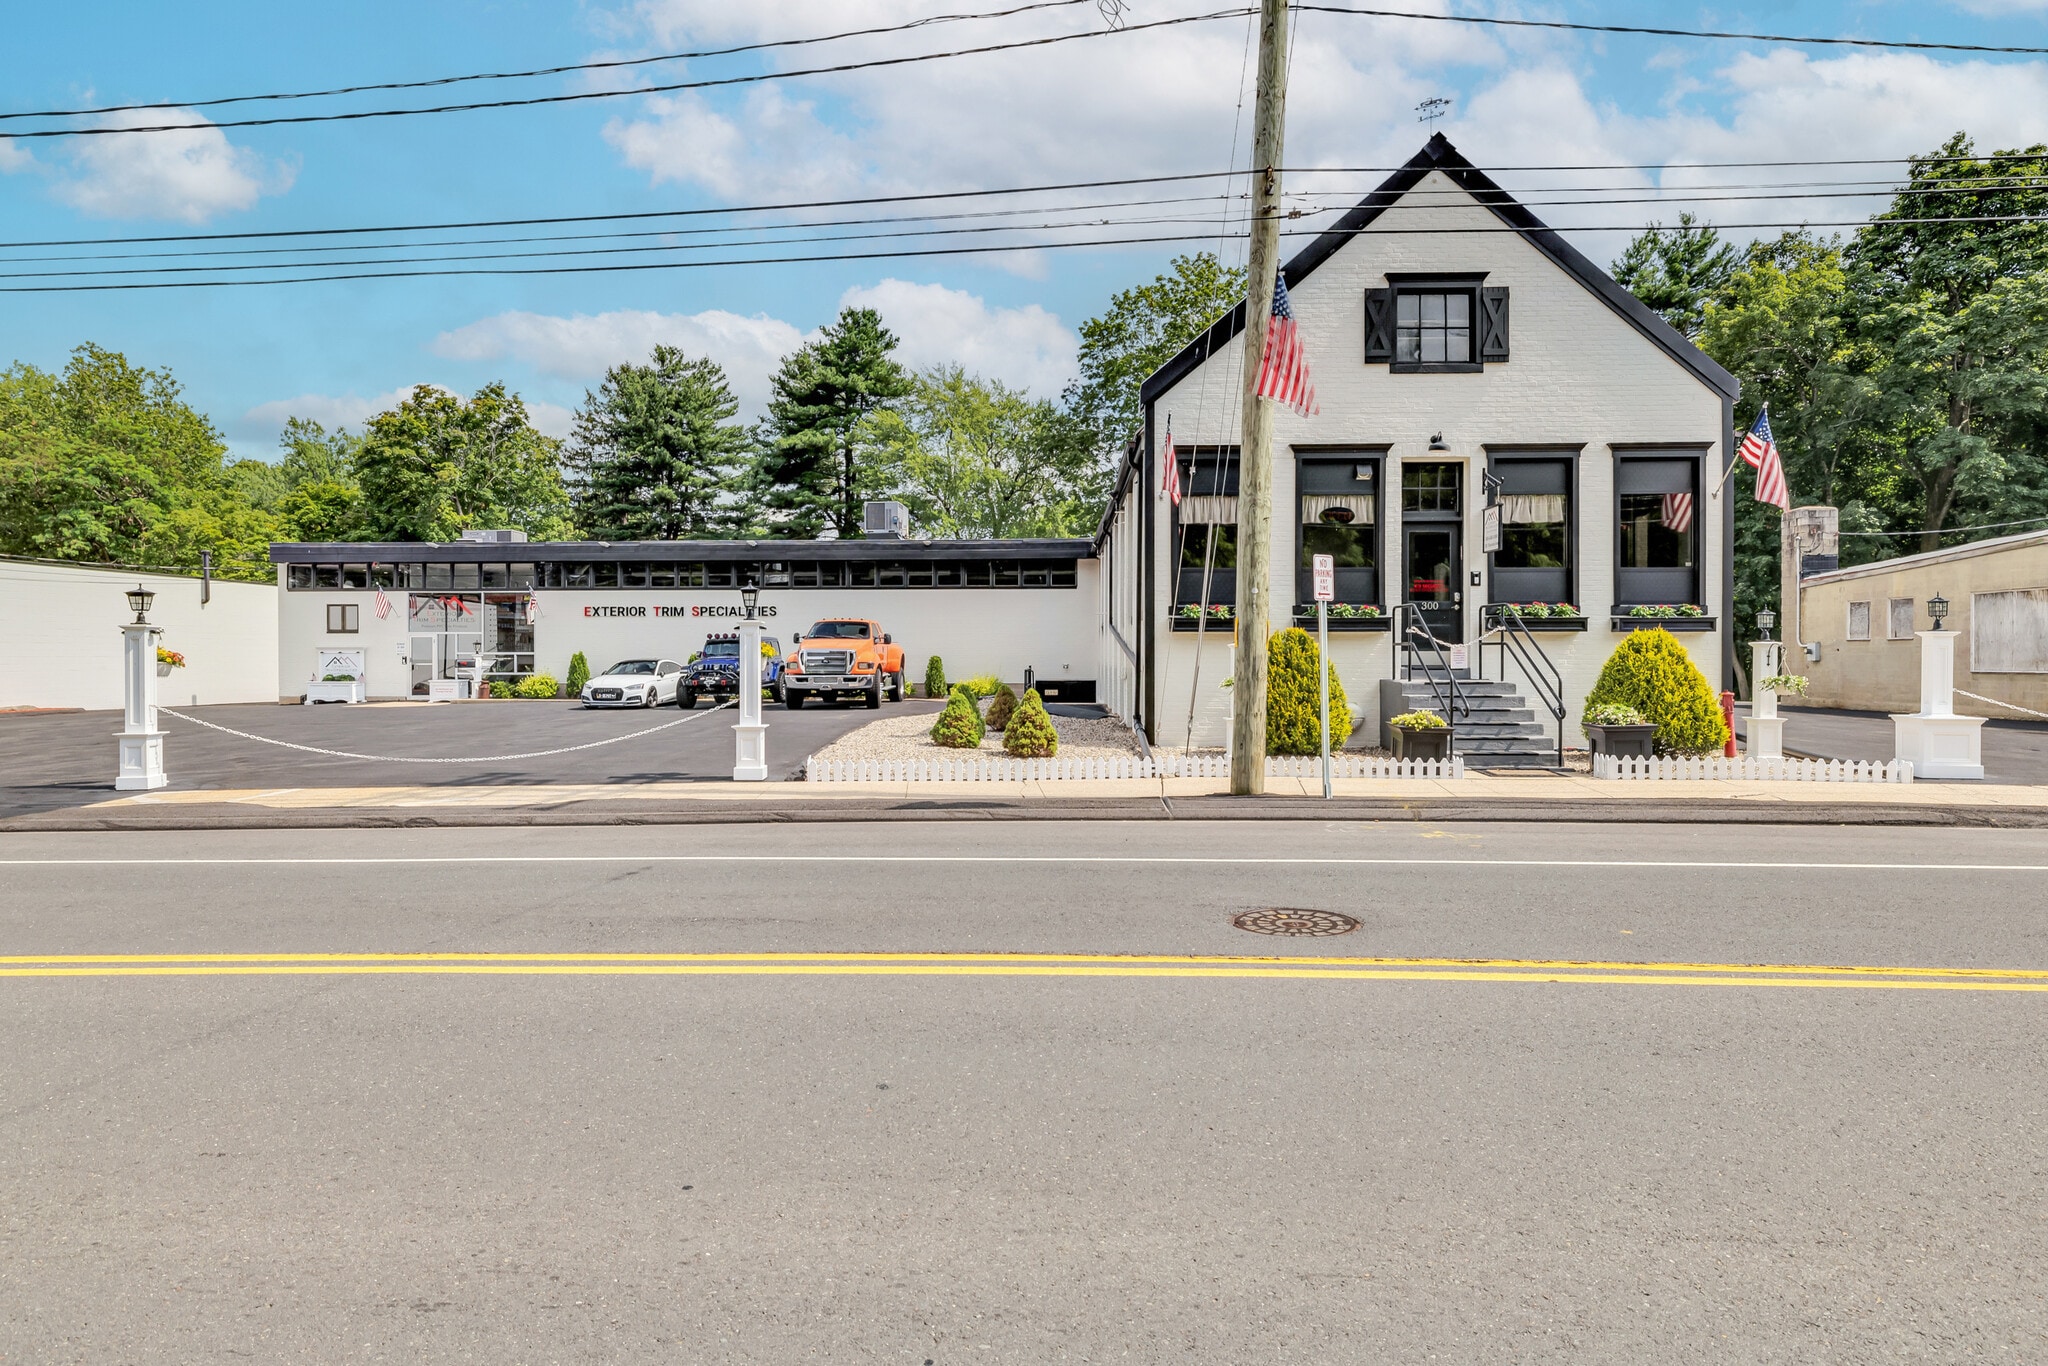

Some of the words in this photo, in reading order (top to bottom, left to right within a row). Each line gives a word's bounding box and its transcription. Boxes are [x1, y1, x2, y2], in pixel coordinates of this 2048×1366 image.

[1319, 559, 1328, 569] NO
[1314, 569, 1333, 578] PARKING
[1420, 601, 1439, 610] 300
[584, 606, 647, 617] EXTERIOR
[653, 606, 685, 617] TRIM
[691, 606, 777, 617] SPECIALIES
